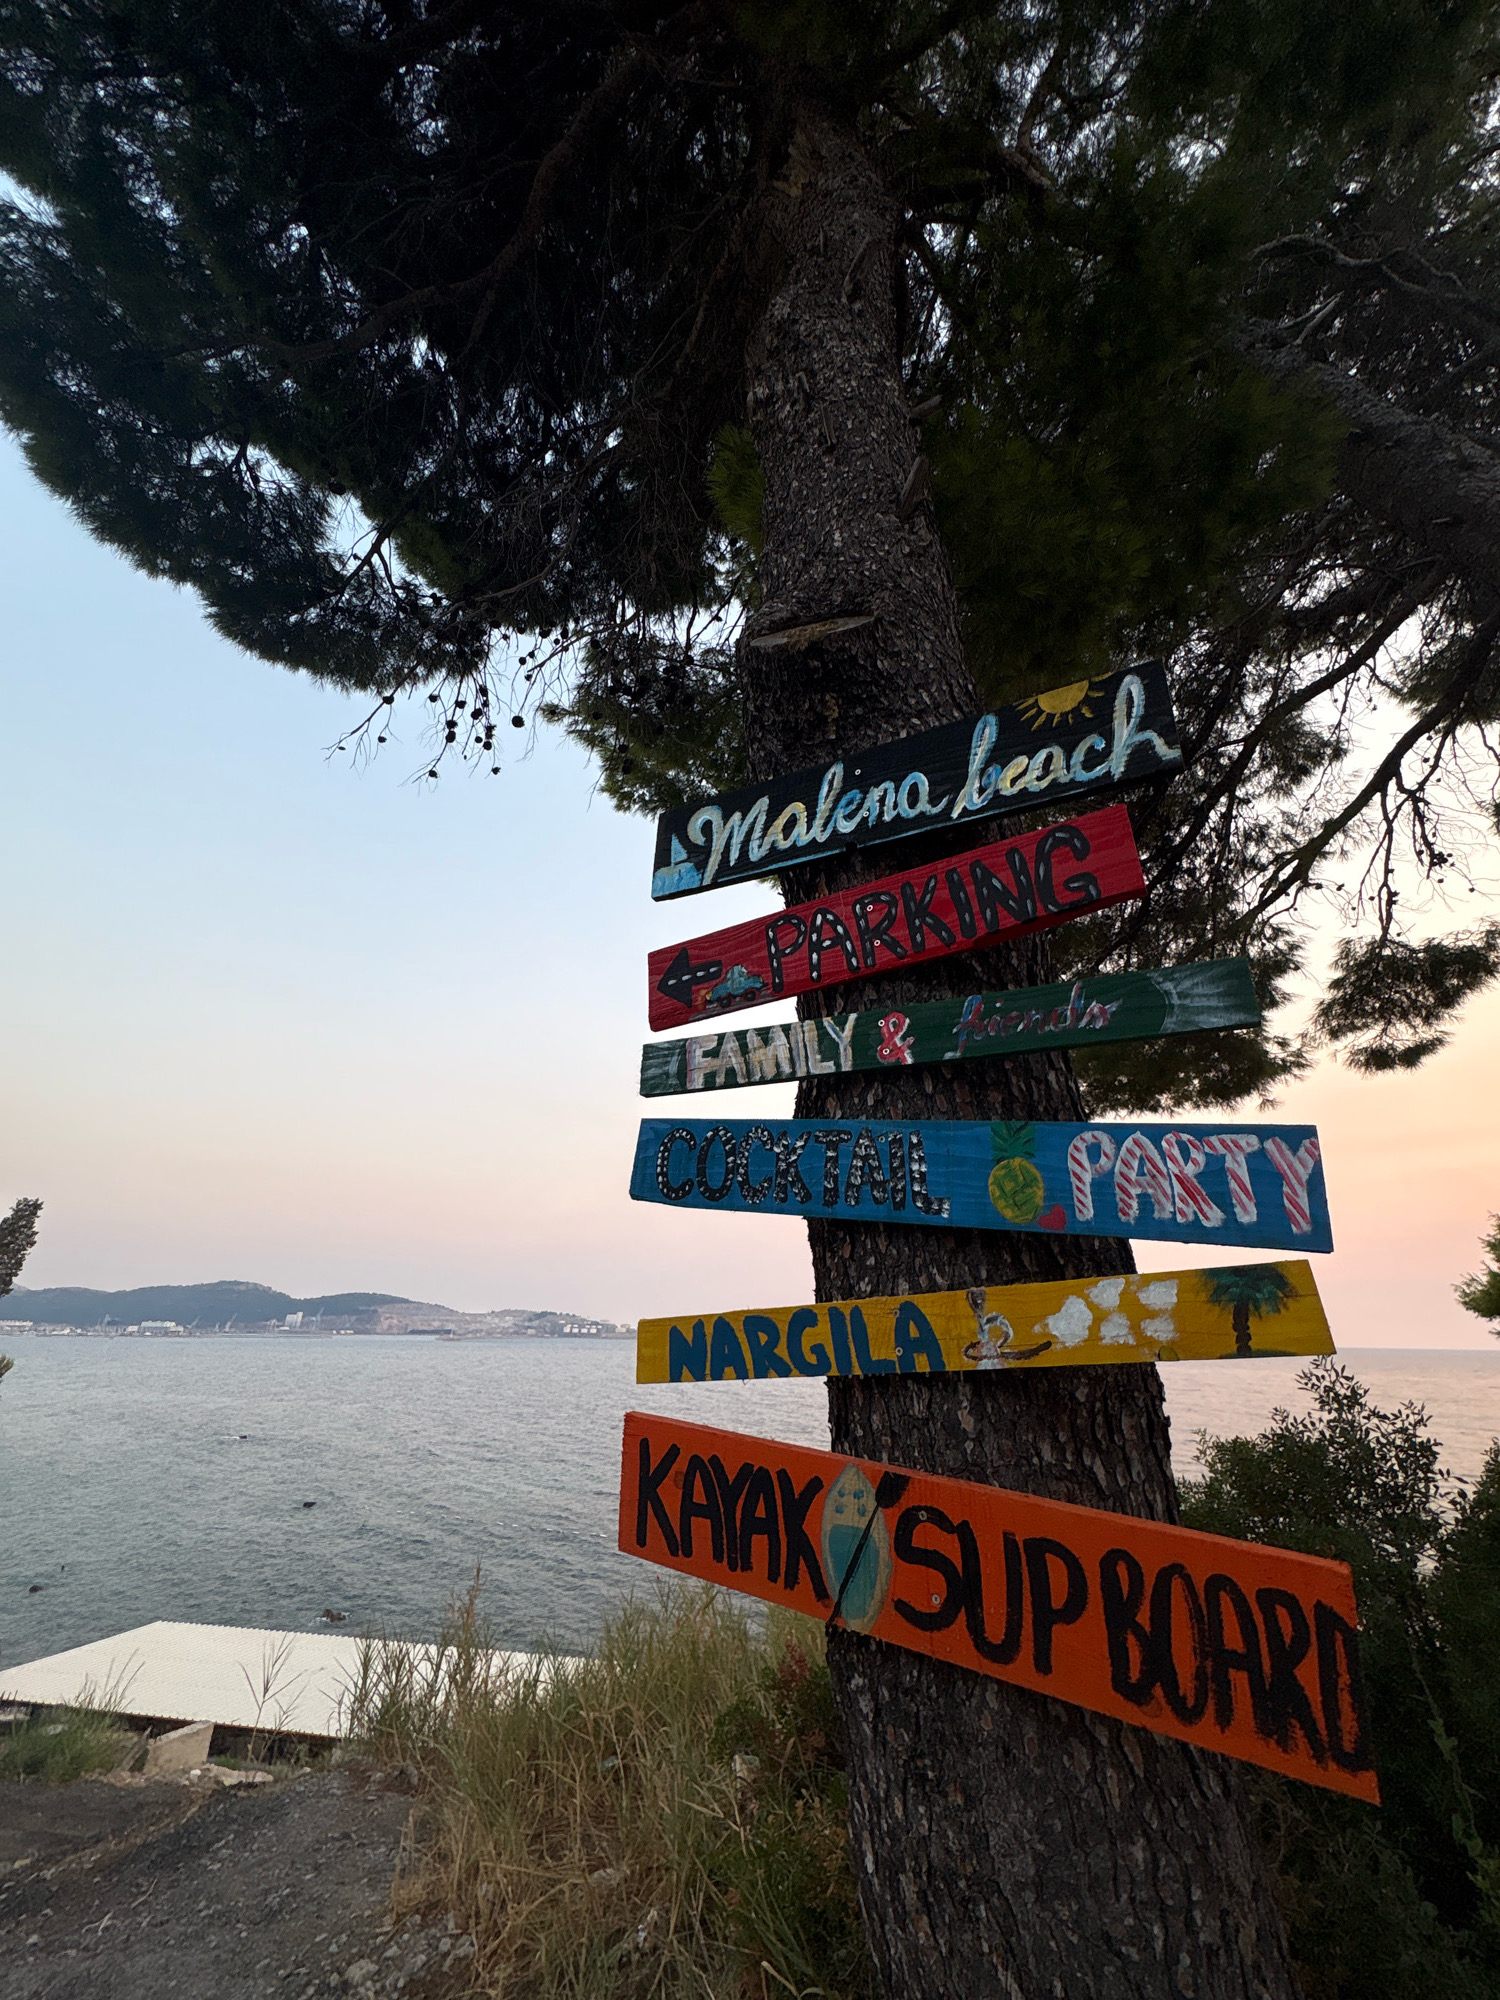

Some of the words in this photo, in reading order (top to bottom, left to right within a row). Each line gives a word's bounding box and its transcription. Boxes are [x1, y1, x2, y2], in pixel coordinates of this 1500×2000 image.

[950, 673, 1182, 820] beach
[765, 824, 1100, 993] PARKING
[686, 1012, 857, 1090] FAMILY
[877, 1011, 915, 1064] &
[656, 1124, 951, 1218] COCKTAIL
[1067, 1130, 1320, 1235] PARTY
[668, 1300, 946, 1383] NARGILA
[635, 1437, 831, 1605] KAYAK
